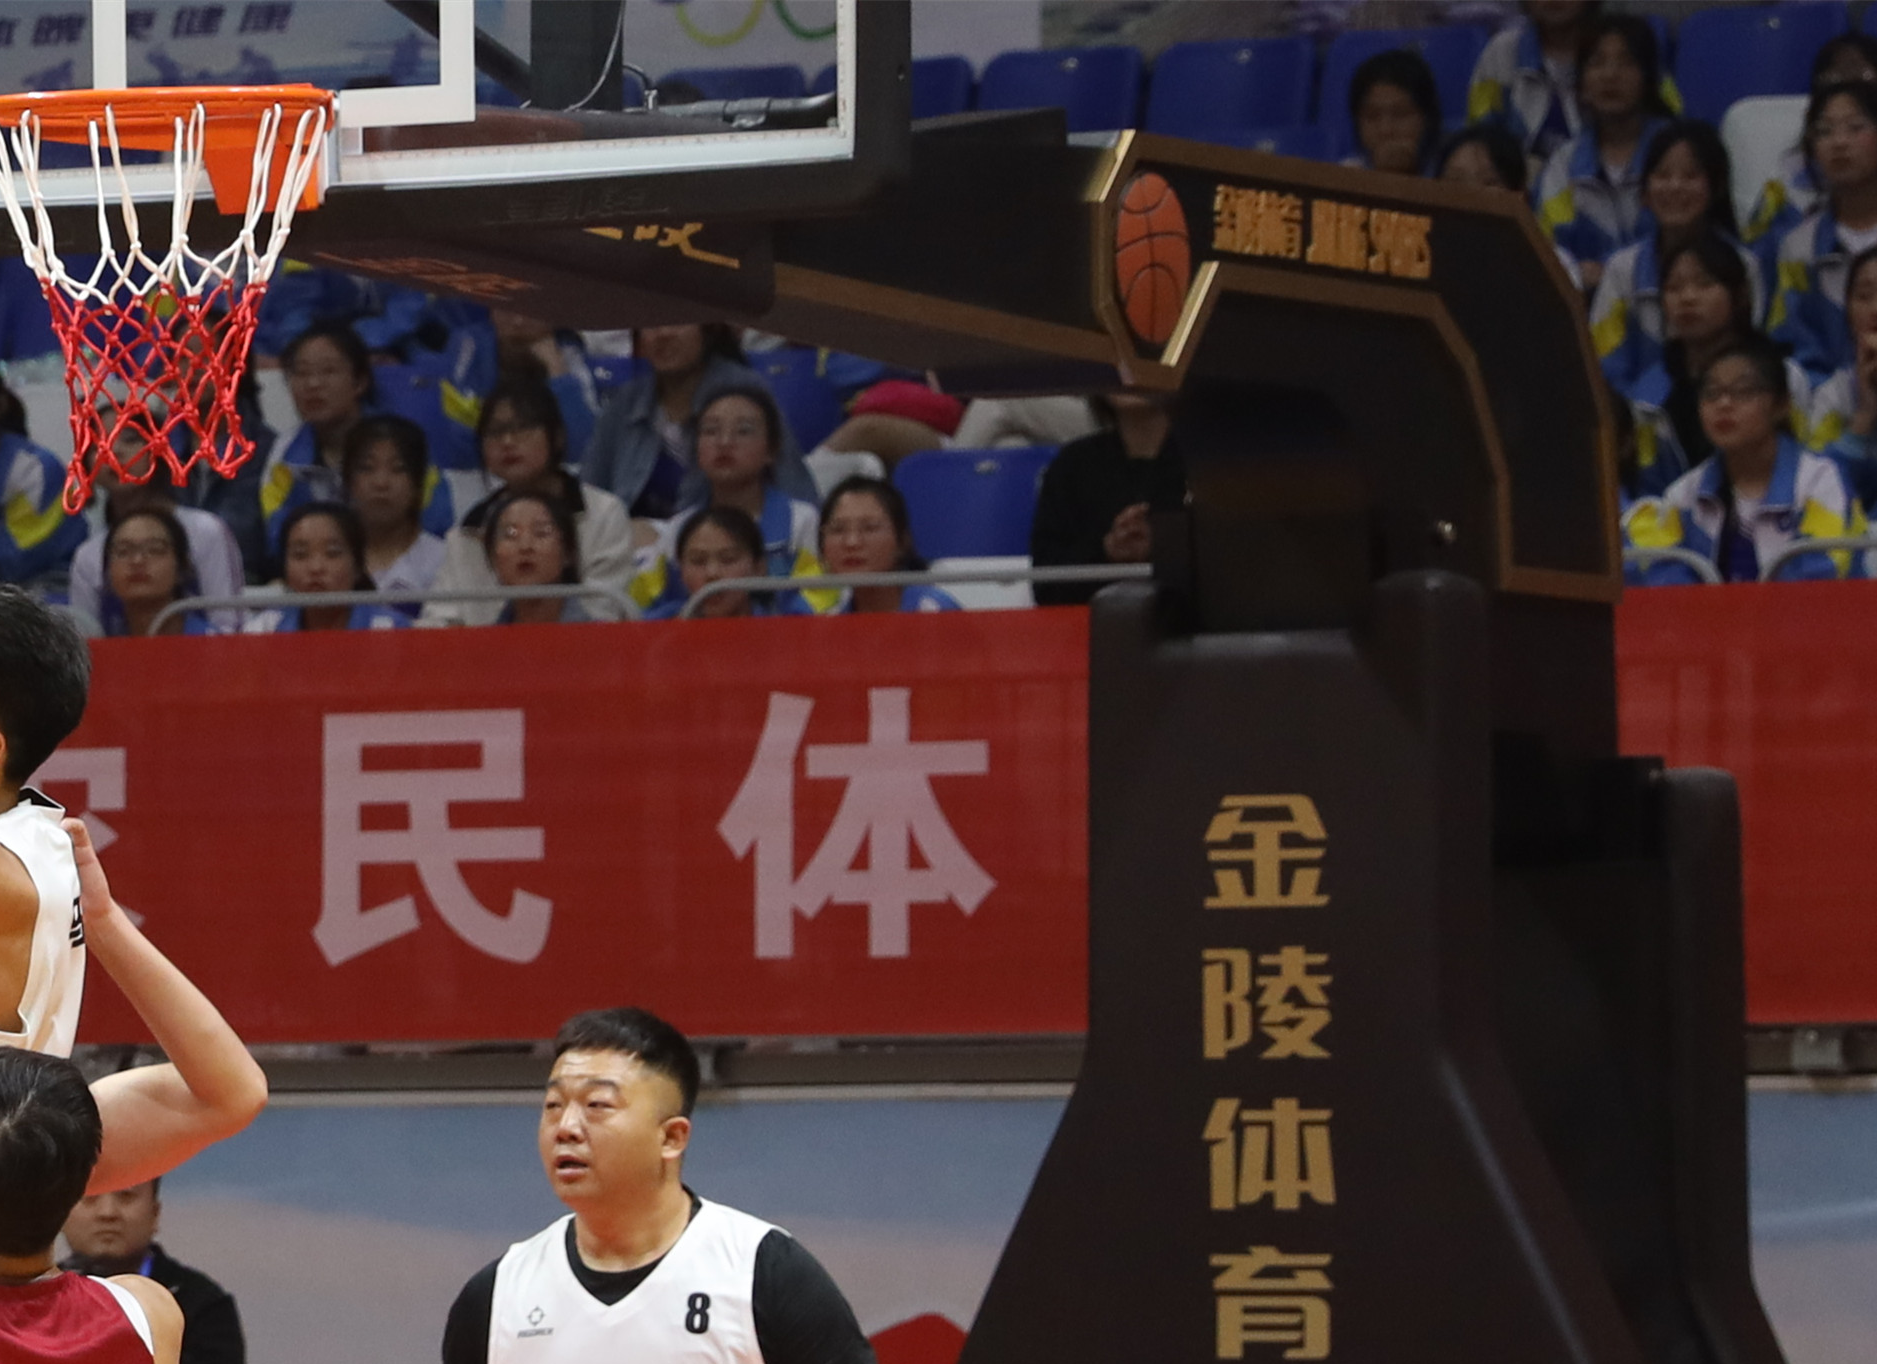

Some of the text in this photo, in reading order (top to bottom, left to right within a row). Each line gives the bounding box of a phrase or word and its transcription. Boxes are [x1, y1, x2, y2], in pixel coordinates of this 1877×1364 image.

[1201, 792, 1337, 1361] 金陵体育
[684, 1292, 712, 1335] 8
